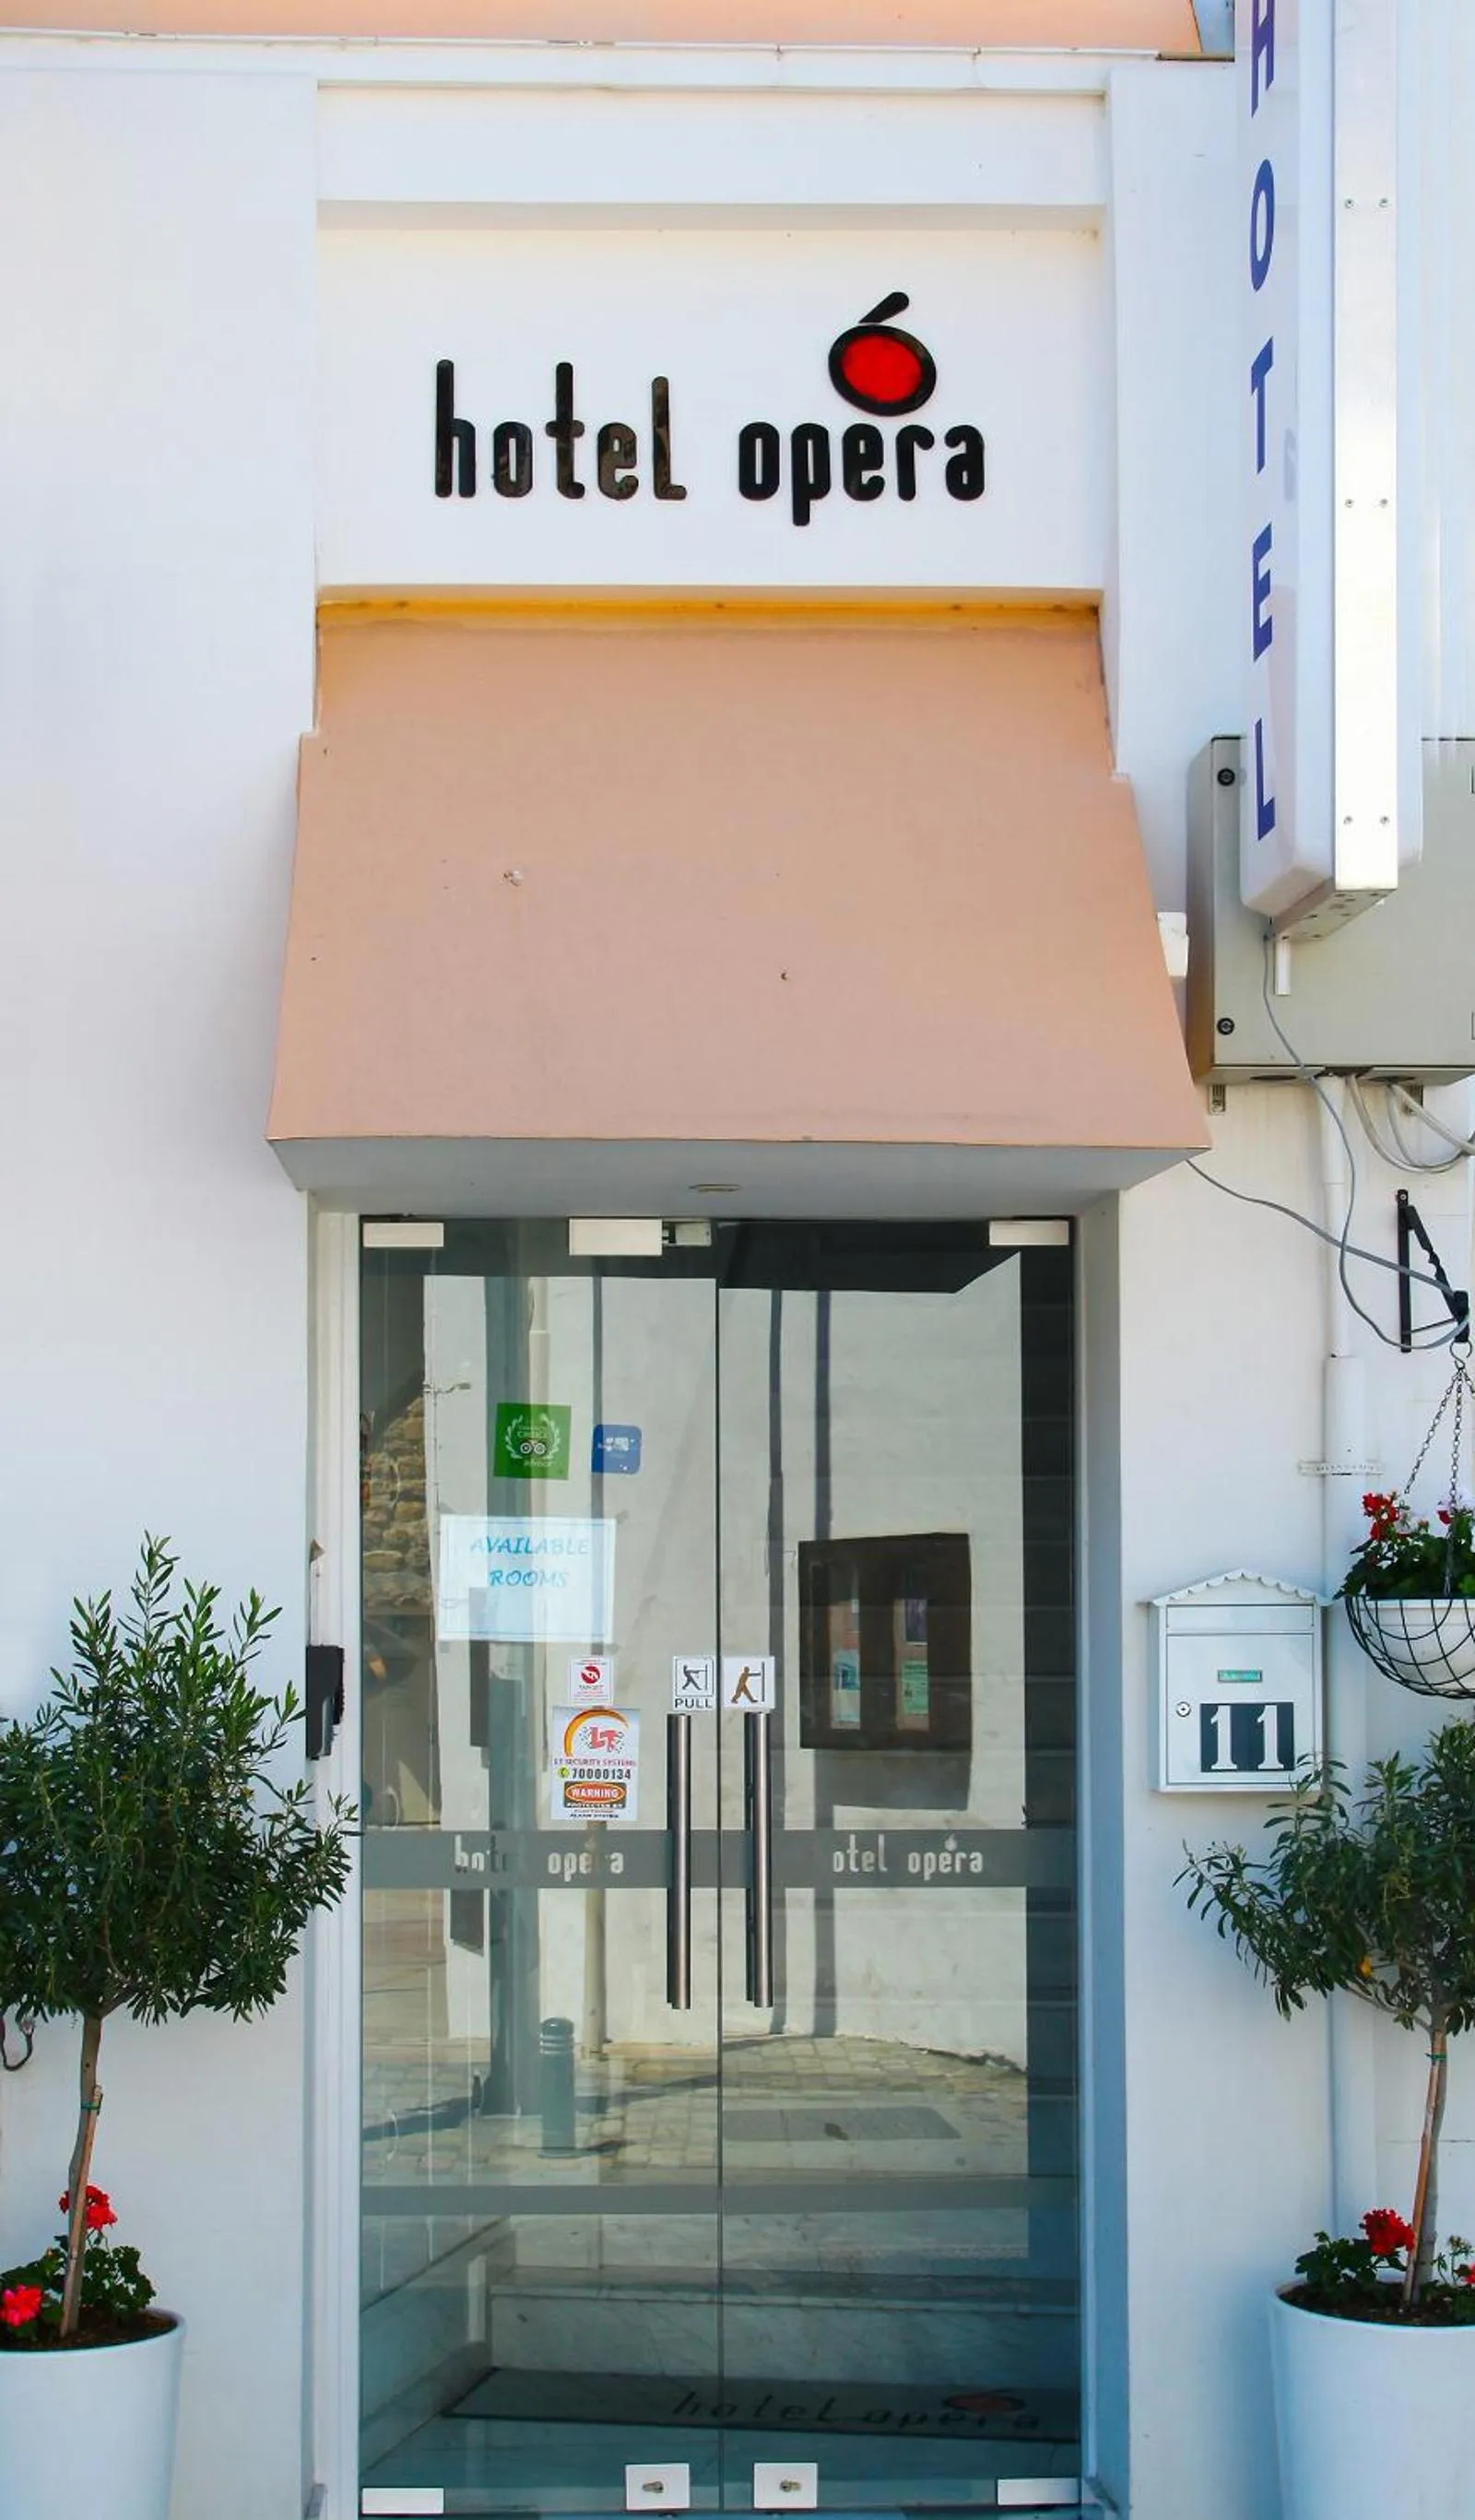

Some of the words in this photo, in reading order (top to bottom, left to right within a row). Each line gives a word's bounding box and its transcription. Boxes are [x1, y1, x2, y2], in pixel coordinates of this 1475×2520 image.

[1249, 0, 1276, 842] HOTEL
[434, 359, 688, 500] hotel
[738, 420, 985, 527] opera
[470, 1535, 590, 1555] AVAILABLE
[490, 1569, 569, 1587] ROOMS
[675, 1698, 713, 1709] PULL
[1210, 1705, 1284, 1769] 11
[572, 1768, 631, 1780] 70000134
[572, 1788, 620, 1799] WARNING
[833, 1834, 888, 1873] otel
[671, 2390, 837, 2423] hotel
